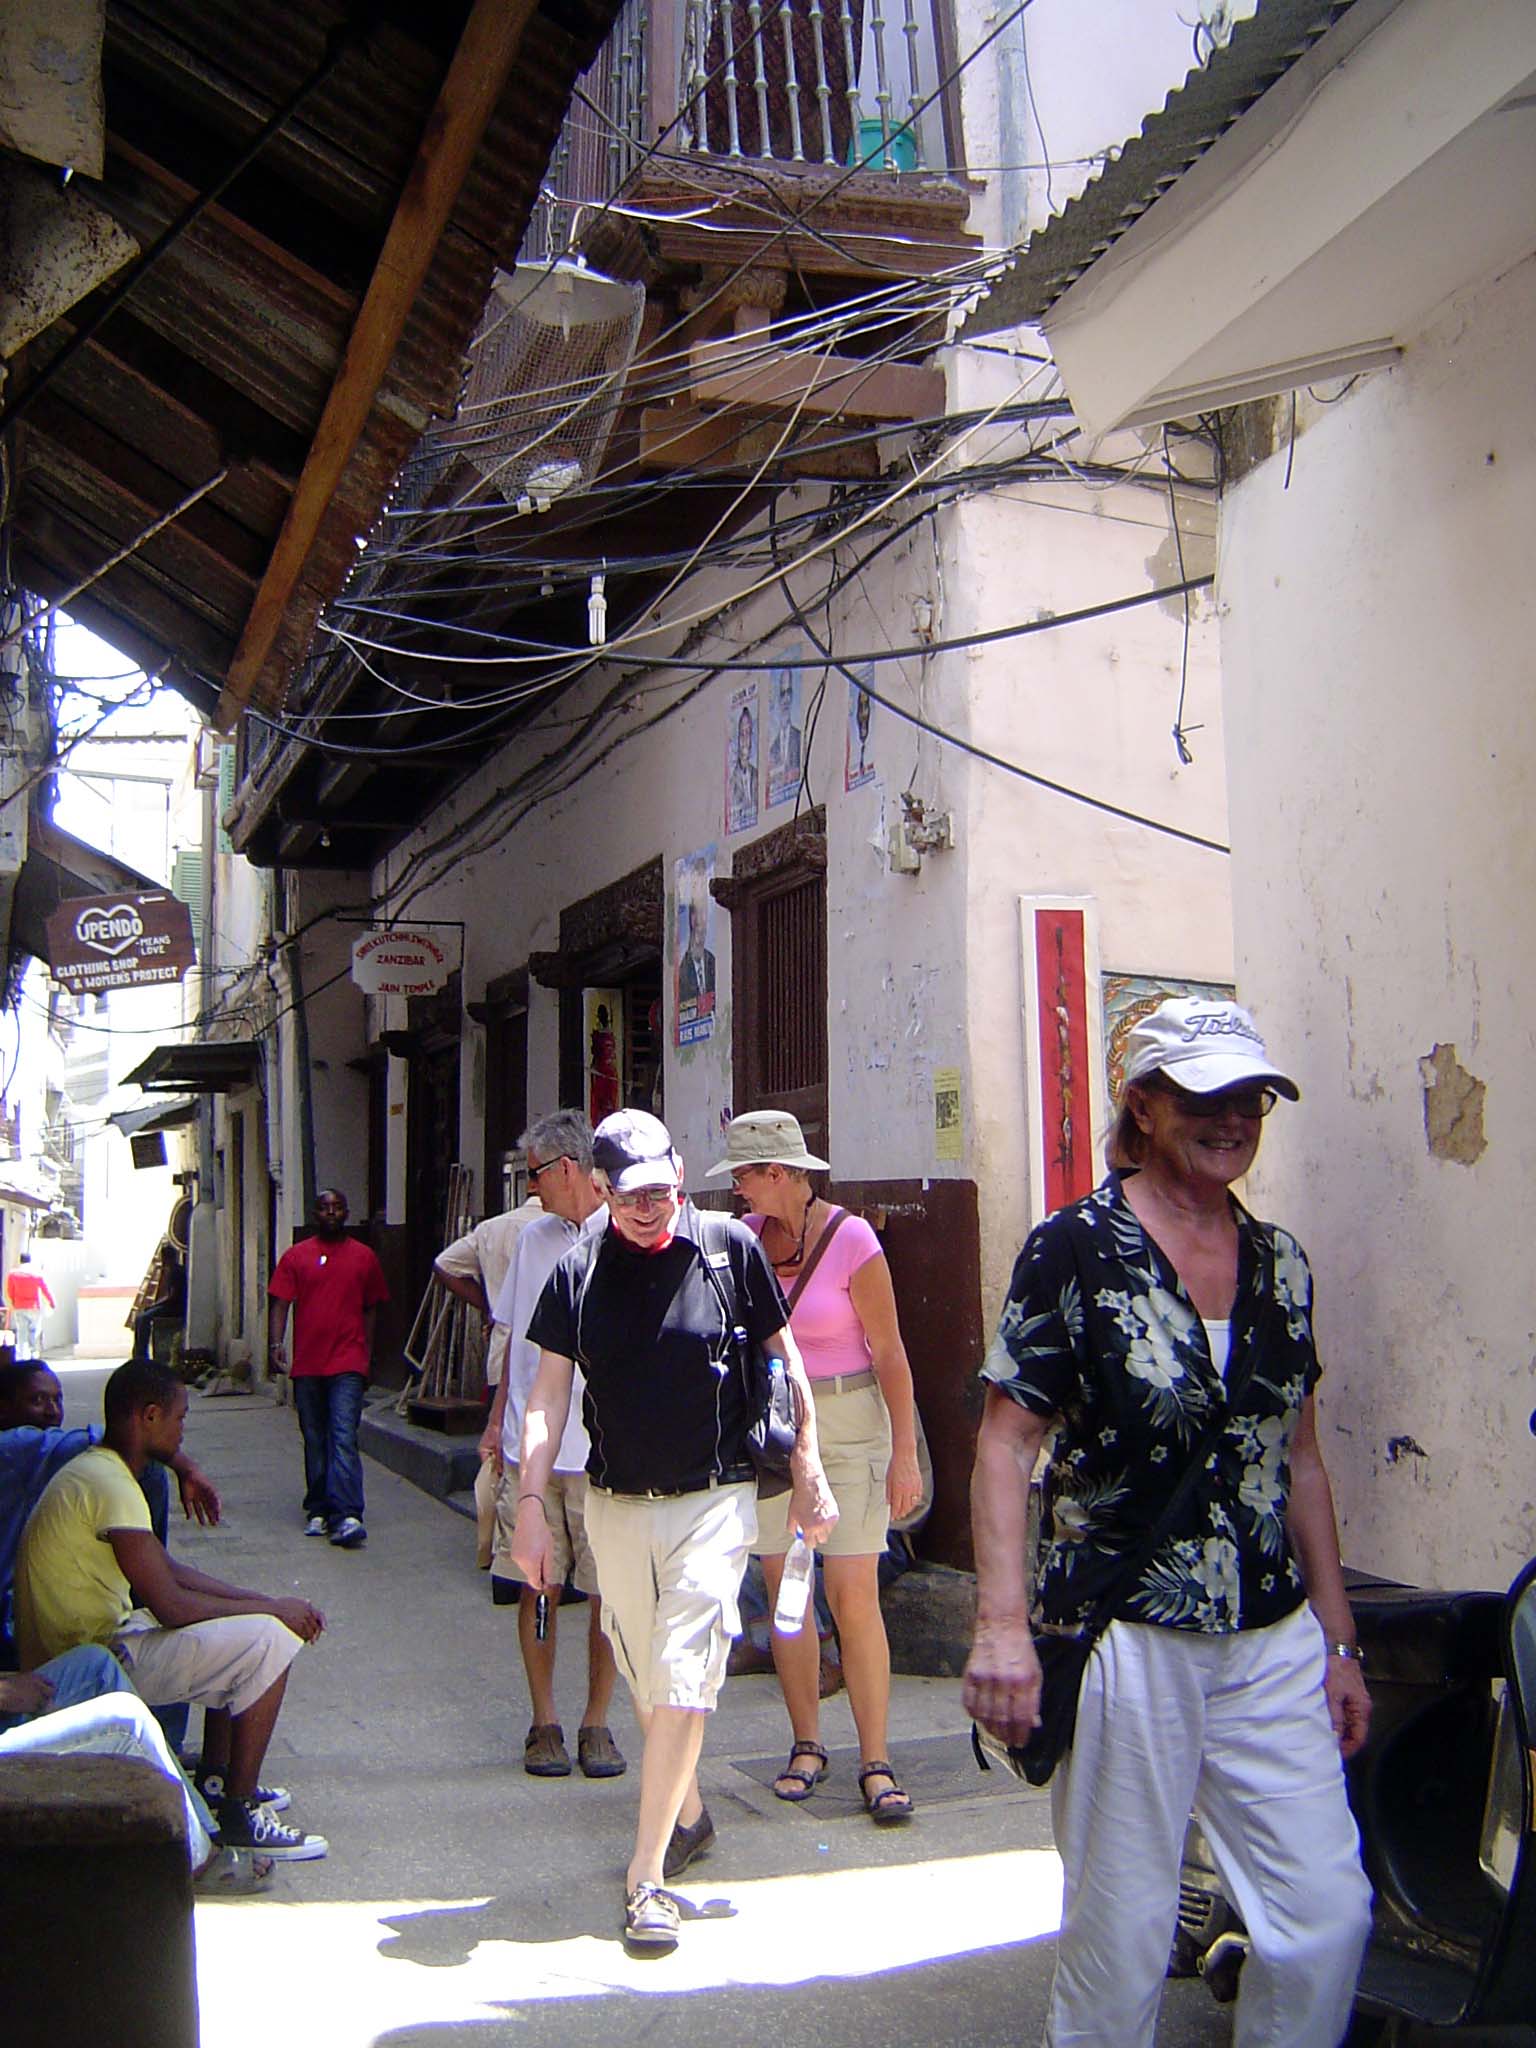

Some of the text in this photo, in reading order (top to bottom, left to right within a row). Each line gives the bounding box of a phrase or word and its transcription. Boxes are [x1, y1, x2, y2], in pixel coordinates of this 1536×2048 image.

[76, 918, 143, 942] UPENDO
[141, 945, 165, 956] LOVE
[376, 954, 425, 966] ZANZIBAR
[57, 957, 139, 978] CLOTHING SHOP
[73, 979, 83, 989] &
[378, 983, 400, 993] JAIN
